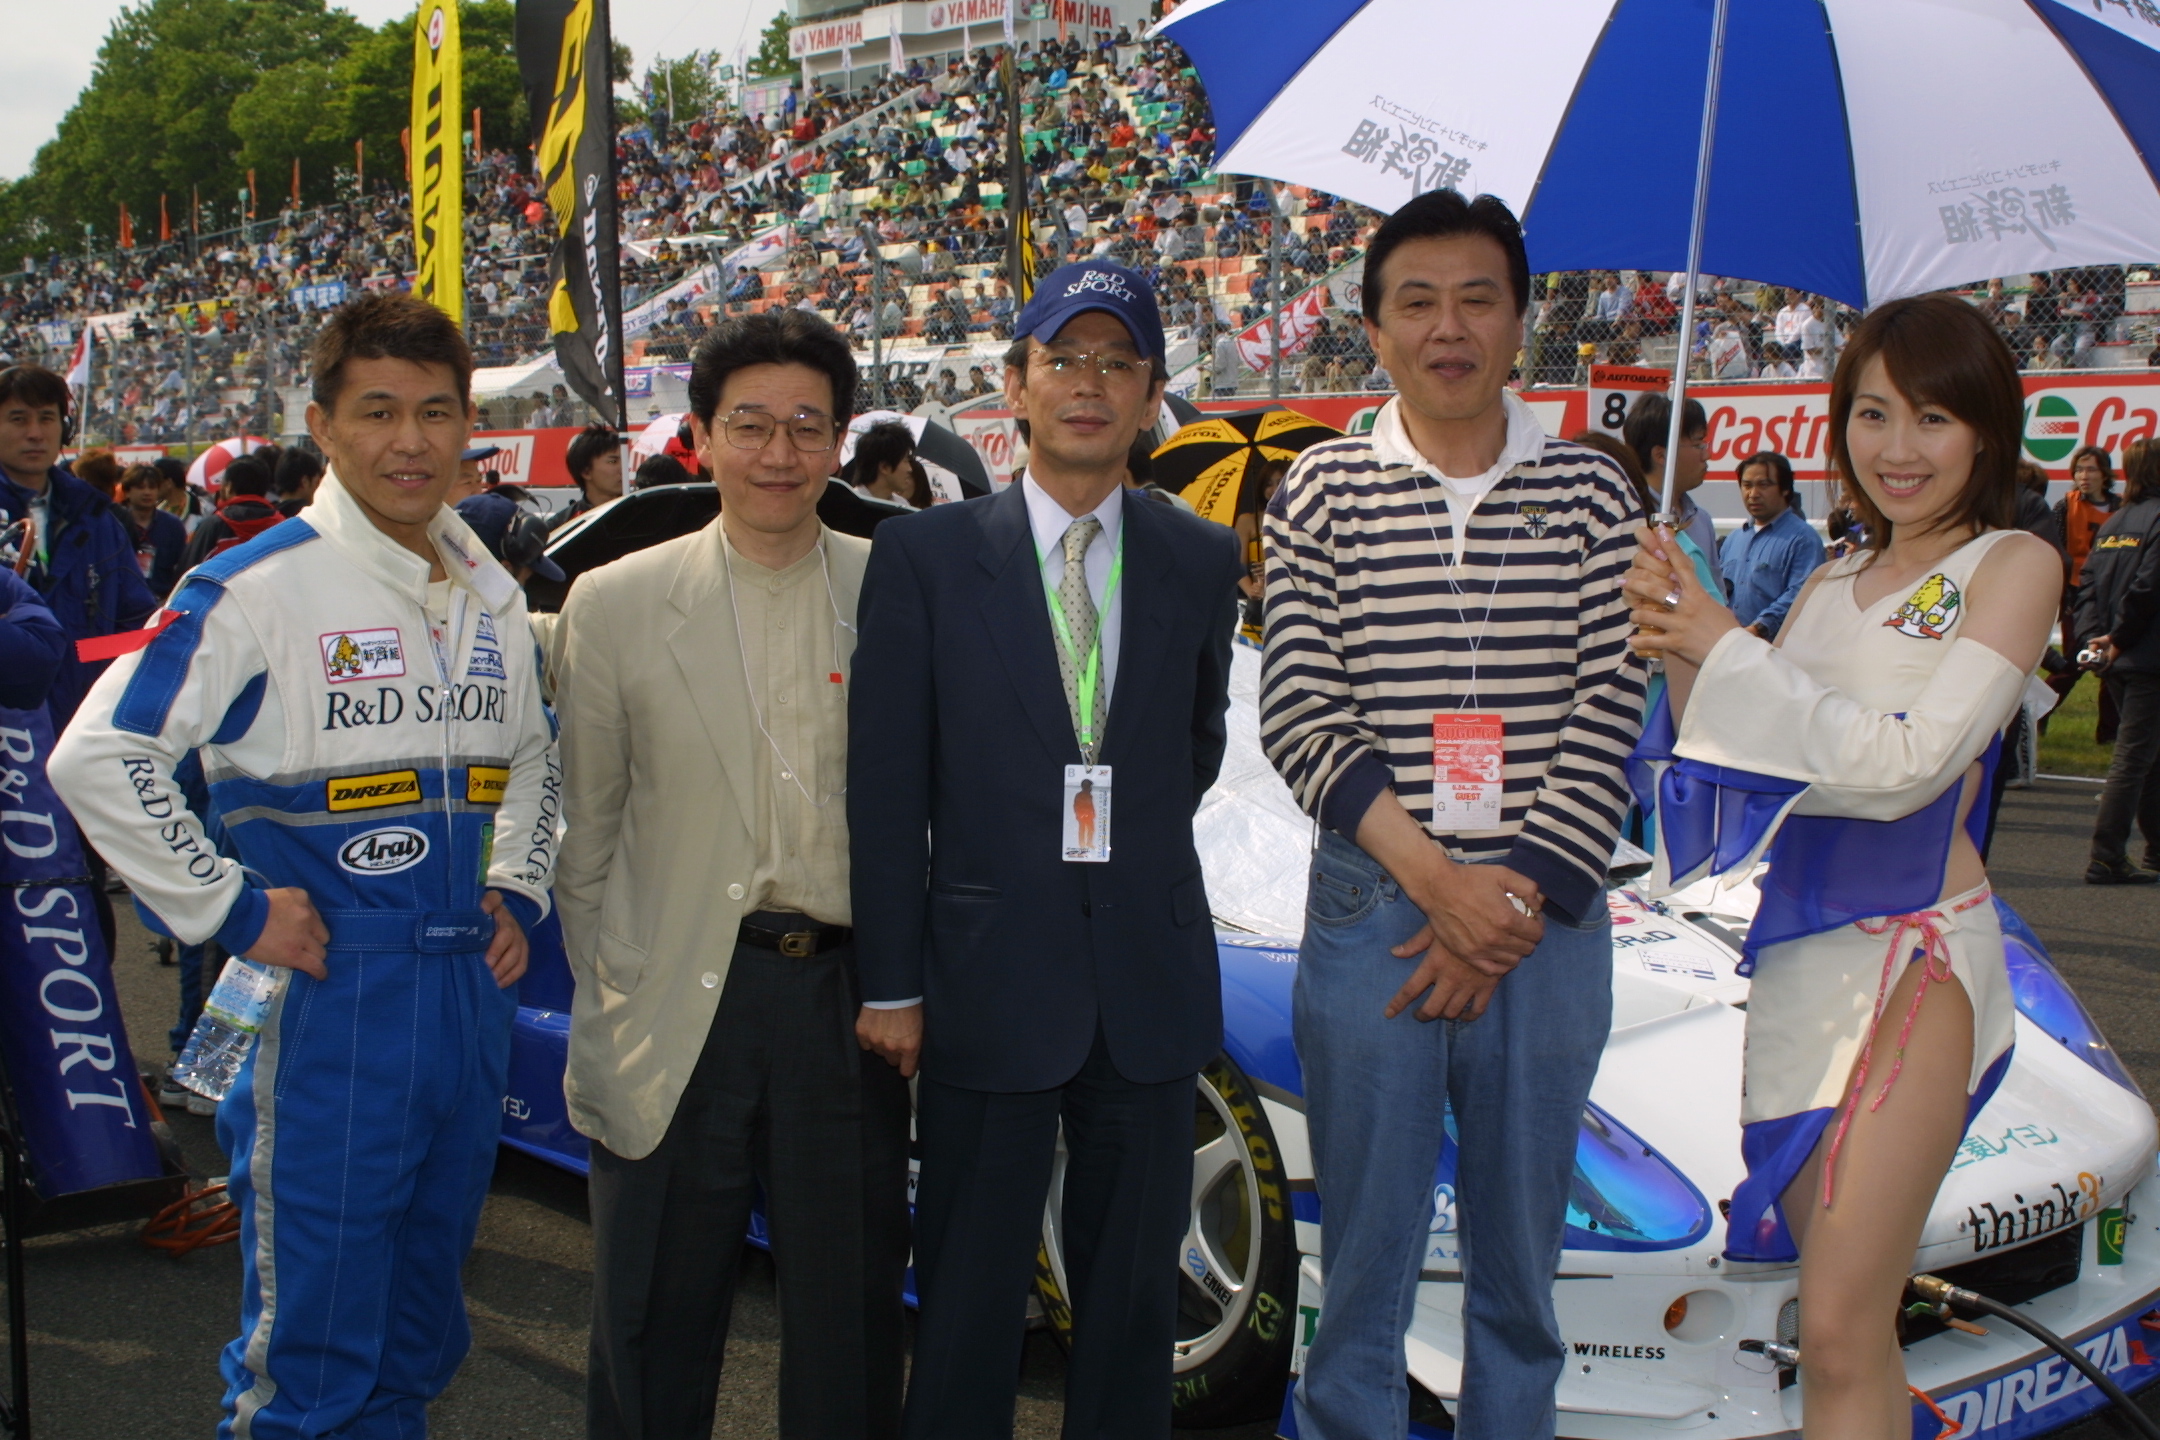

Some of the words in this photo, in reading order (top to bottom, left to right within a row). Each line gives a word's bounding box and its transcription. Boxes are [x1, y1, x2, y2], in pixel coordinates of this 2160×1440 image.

[808, 21, 863, 50] YAMAHA
[1063, 280, 1137, 302] SPORT
[1080, 269, 1125, 286] R&D
[1240, 289, 1317, 368] NGK
[1605, 373, 1669, 384] AUTOBACS
[1601, 392, 1627, 430] 8
[1706, 404, 1832, 462] Castr
[322, 686, 404, 731] R&D
[121, 756, 173, 819] R&D
[332, 780, 416, 801] DIREZZA
[531, 753, 565, 849] SPORT
[1455, 792, 1481, 800] GUEST
[349, 833, 417, 863] Arai
[14, 887, 137, 1130] SPORT
[1202, 1268, 1233, 1307] ENKEI
[1573, 1342, 1666, 1360] WIRELESS
